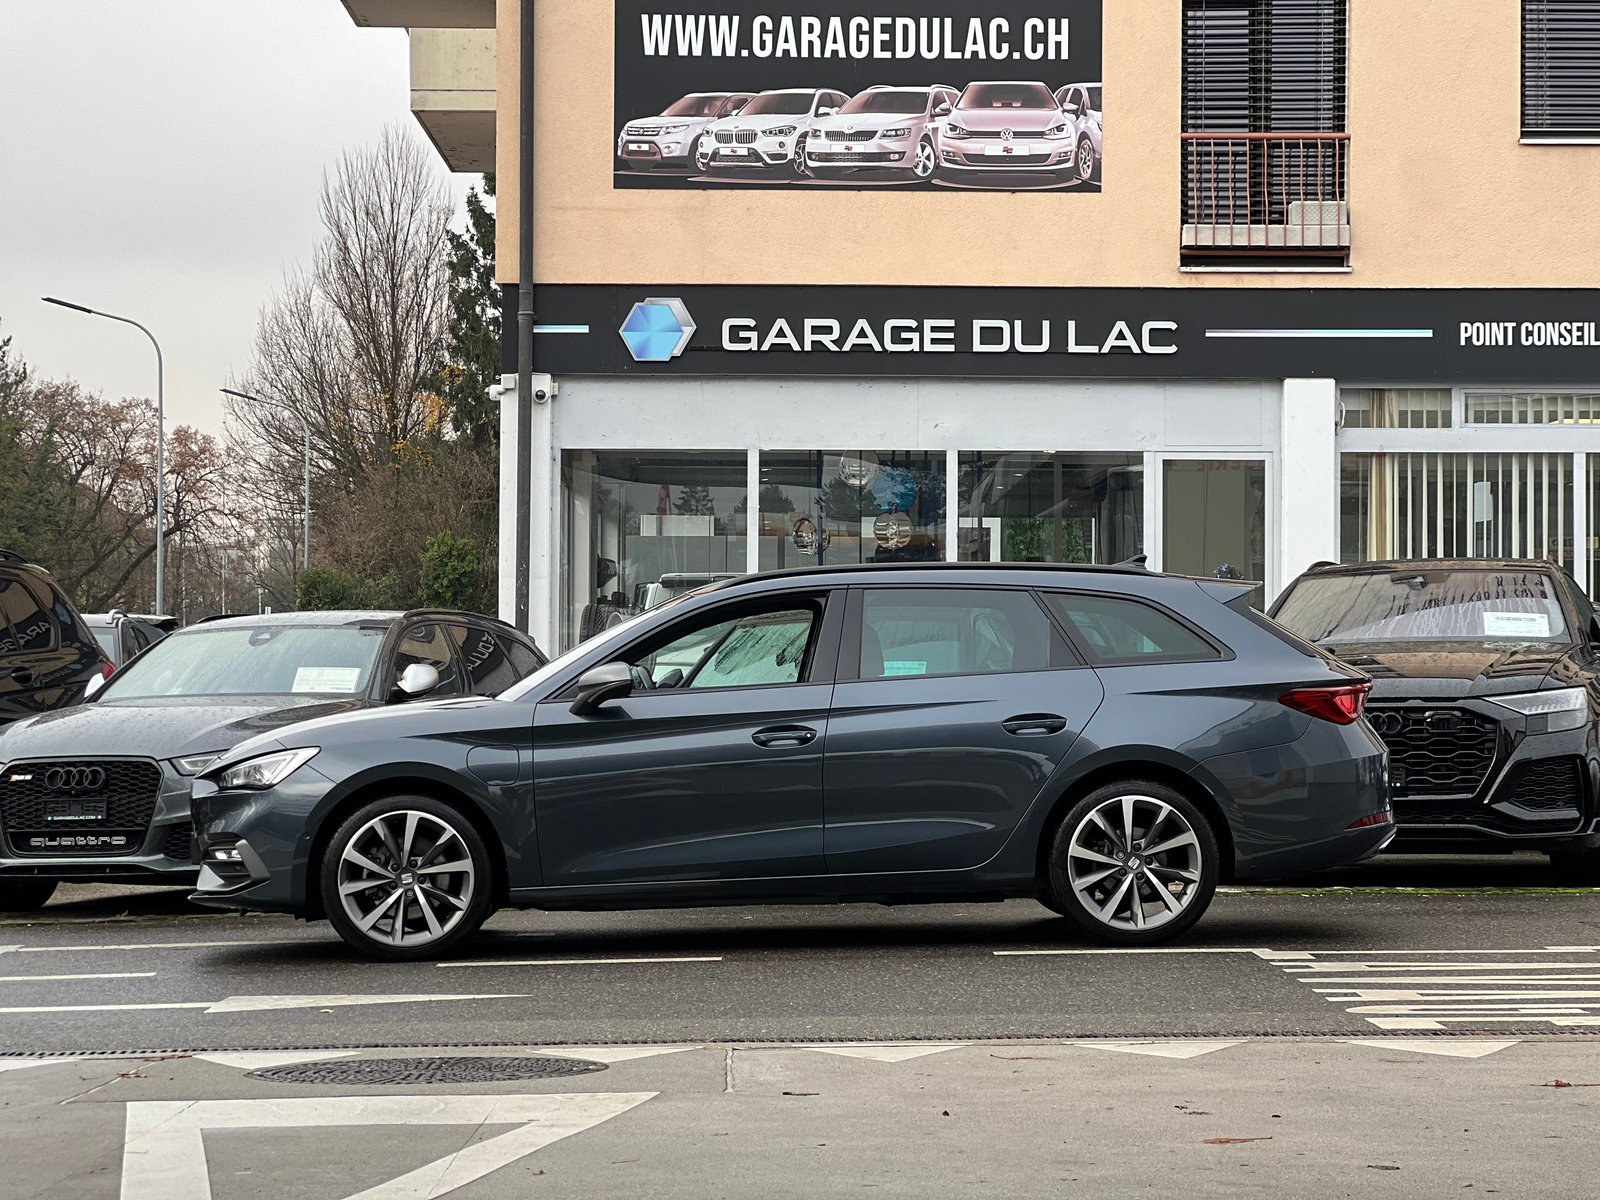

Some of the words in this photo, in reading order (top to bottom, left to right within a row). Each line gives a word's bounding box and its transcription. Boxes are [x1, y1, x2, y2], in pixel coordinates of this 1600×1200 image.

[641, 14, 1070, 60] WWW.GARAGEDULAC.CH
[721, 317, 957, 354] GARAGE
[971, 318, 1052, 354] DU
[1066, 319, 1179, 355] LAC
[1460, 322, 1517, 346] POINT
[1520, 322, 1600, 346] CONSEIL
[30, 835, 127, 848] quattro
